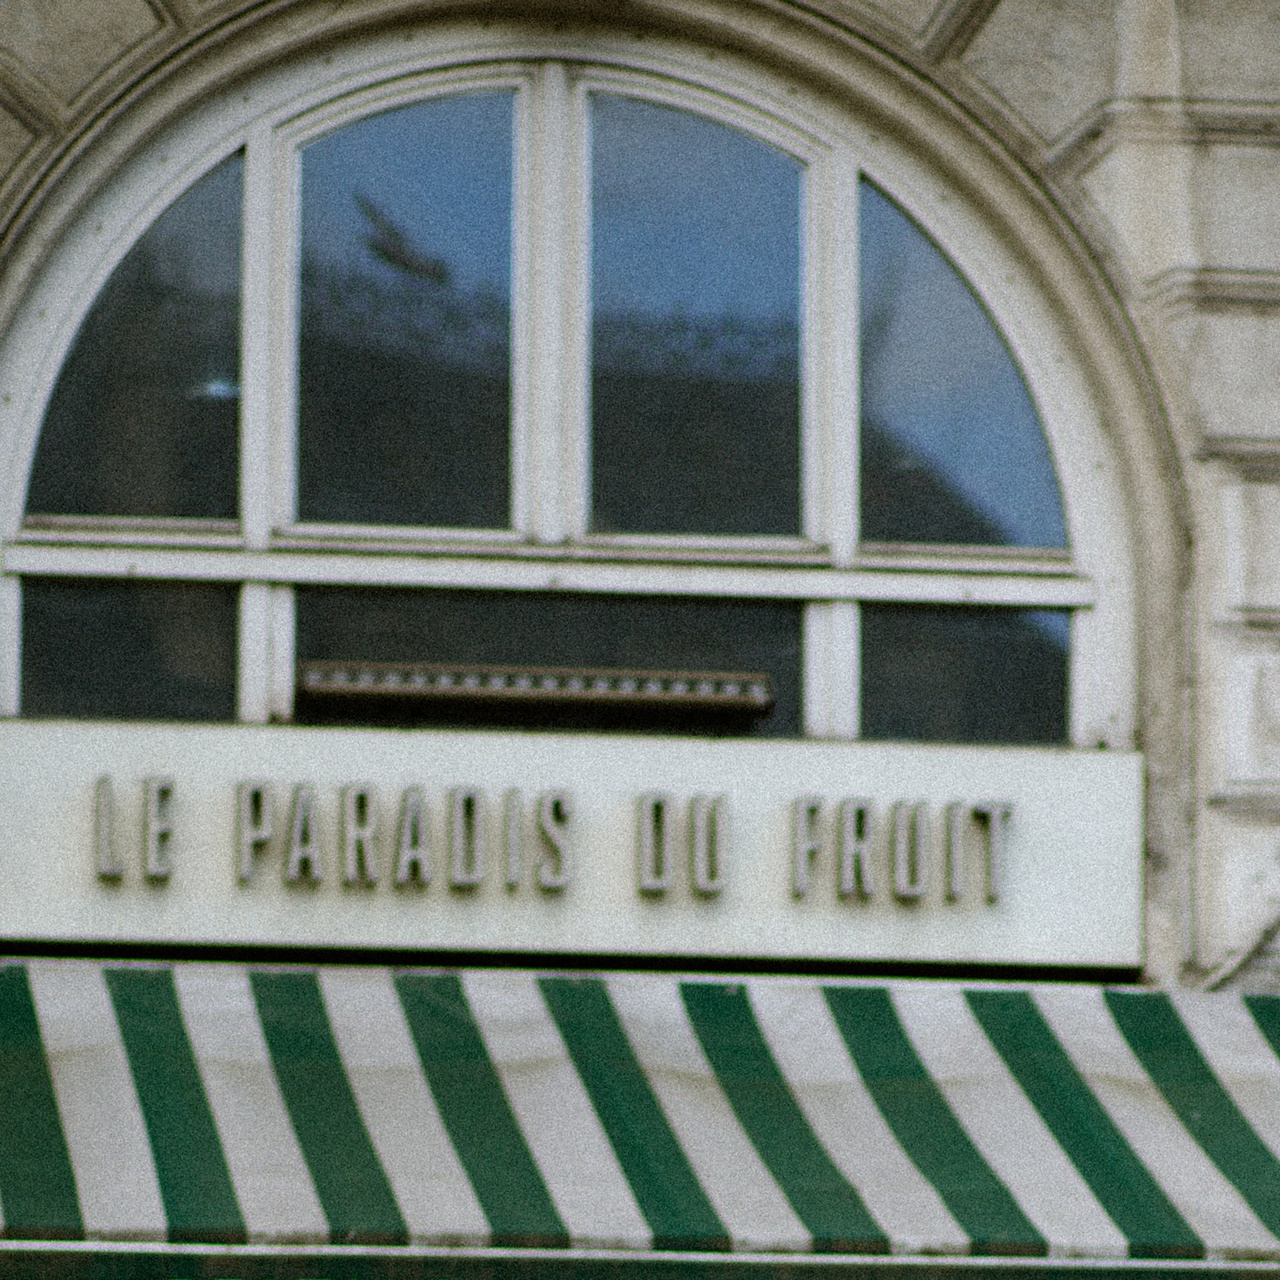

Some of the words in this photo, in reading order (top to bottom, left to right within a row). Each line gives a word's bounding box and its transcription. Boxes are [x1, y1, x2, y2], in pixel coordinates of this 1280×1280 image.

[95, 775, 174, 888] LE
[234, 778, 570, 896] PARADIS
[636, 792, 728, 902] DU
[787, 796, 1014, 907] FRUIT
